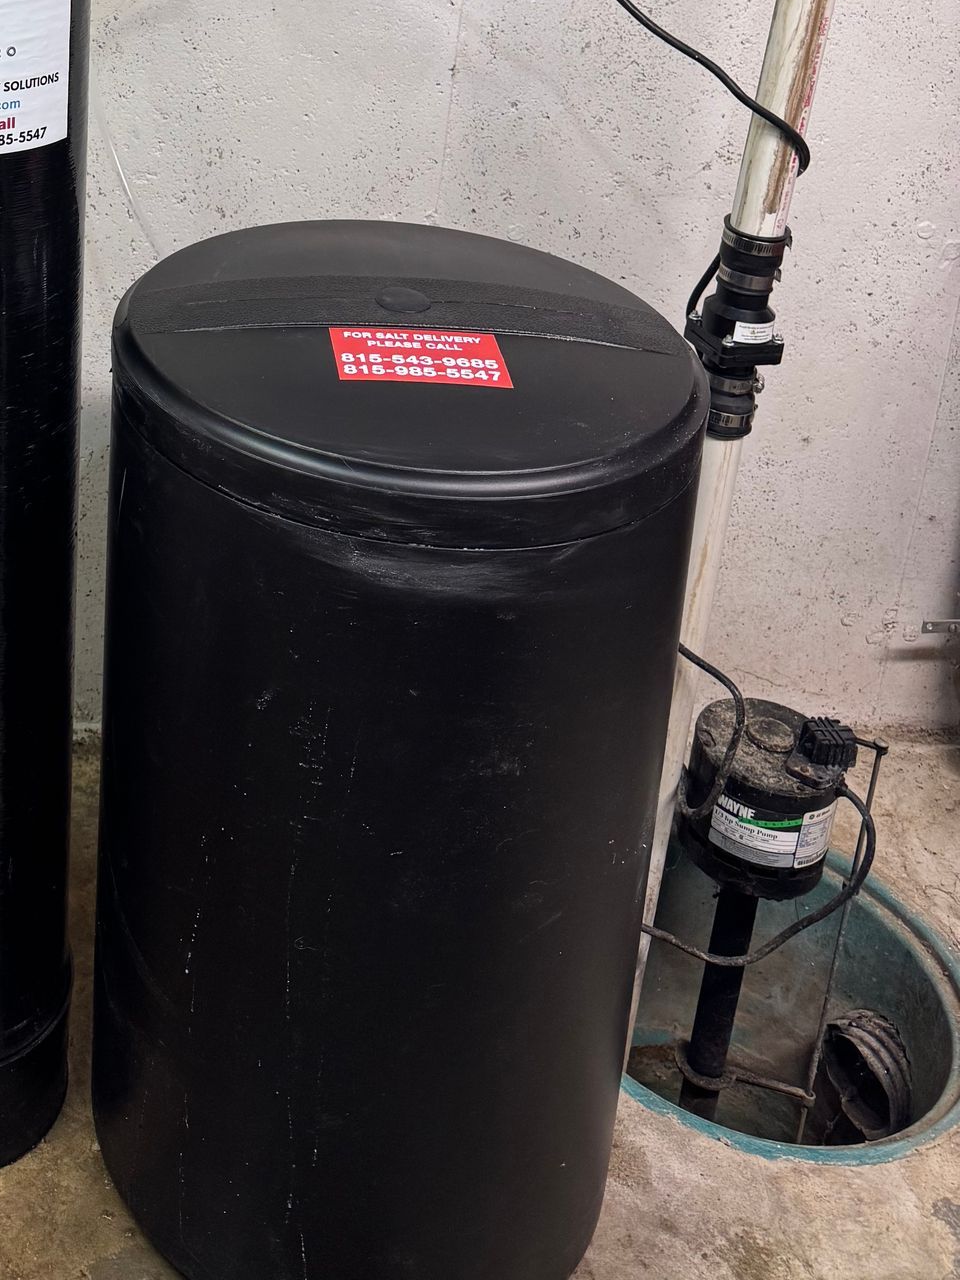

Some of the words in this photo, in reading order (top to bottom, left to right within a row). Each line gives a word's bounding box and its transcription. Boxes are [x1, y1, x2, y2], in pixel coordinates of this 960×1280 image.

[3, 72, 60, 92] SOLUTIONS
[343, 331, 372, 340] FOR
[376, 332, 409, 341] SALT
[413, 334, 481, 344] DELIVERY
[367, 340, 422, 349] PLEASE
[426, 342, 463, 351] CALL
[341, 353, 499, 369] 815-543-9685
[343, 364, 501, 381] 815-985-5547
[717, 794, 756, 820] WAYNE
[757, 829, 778, 840] Pump
